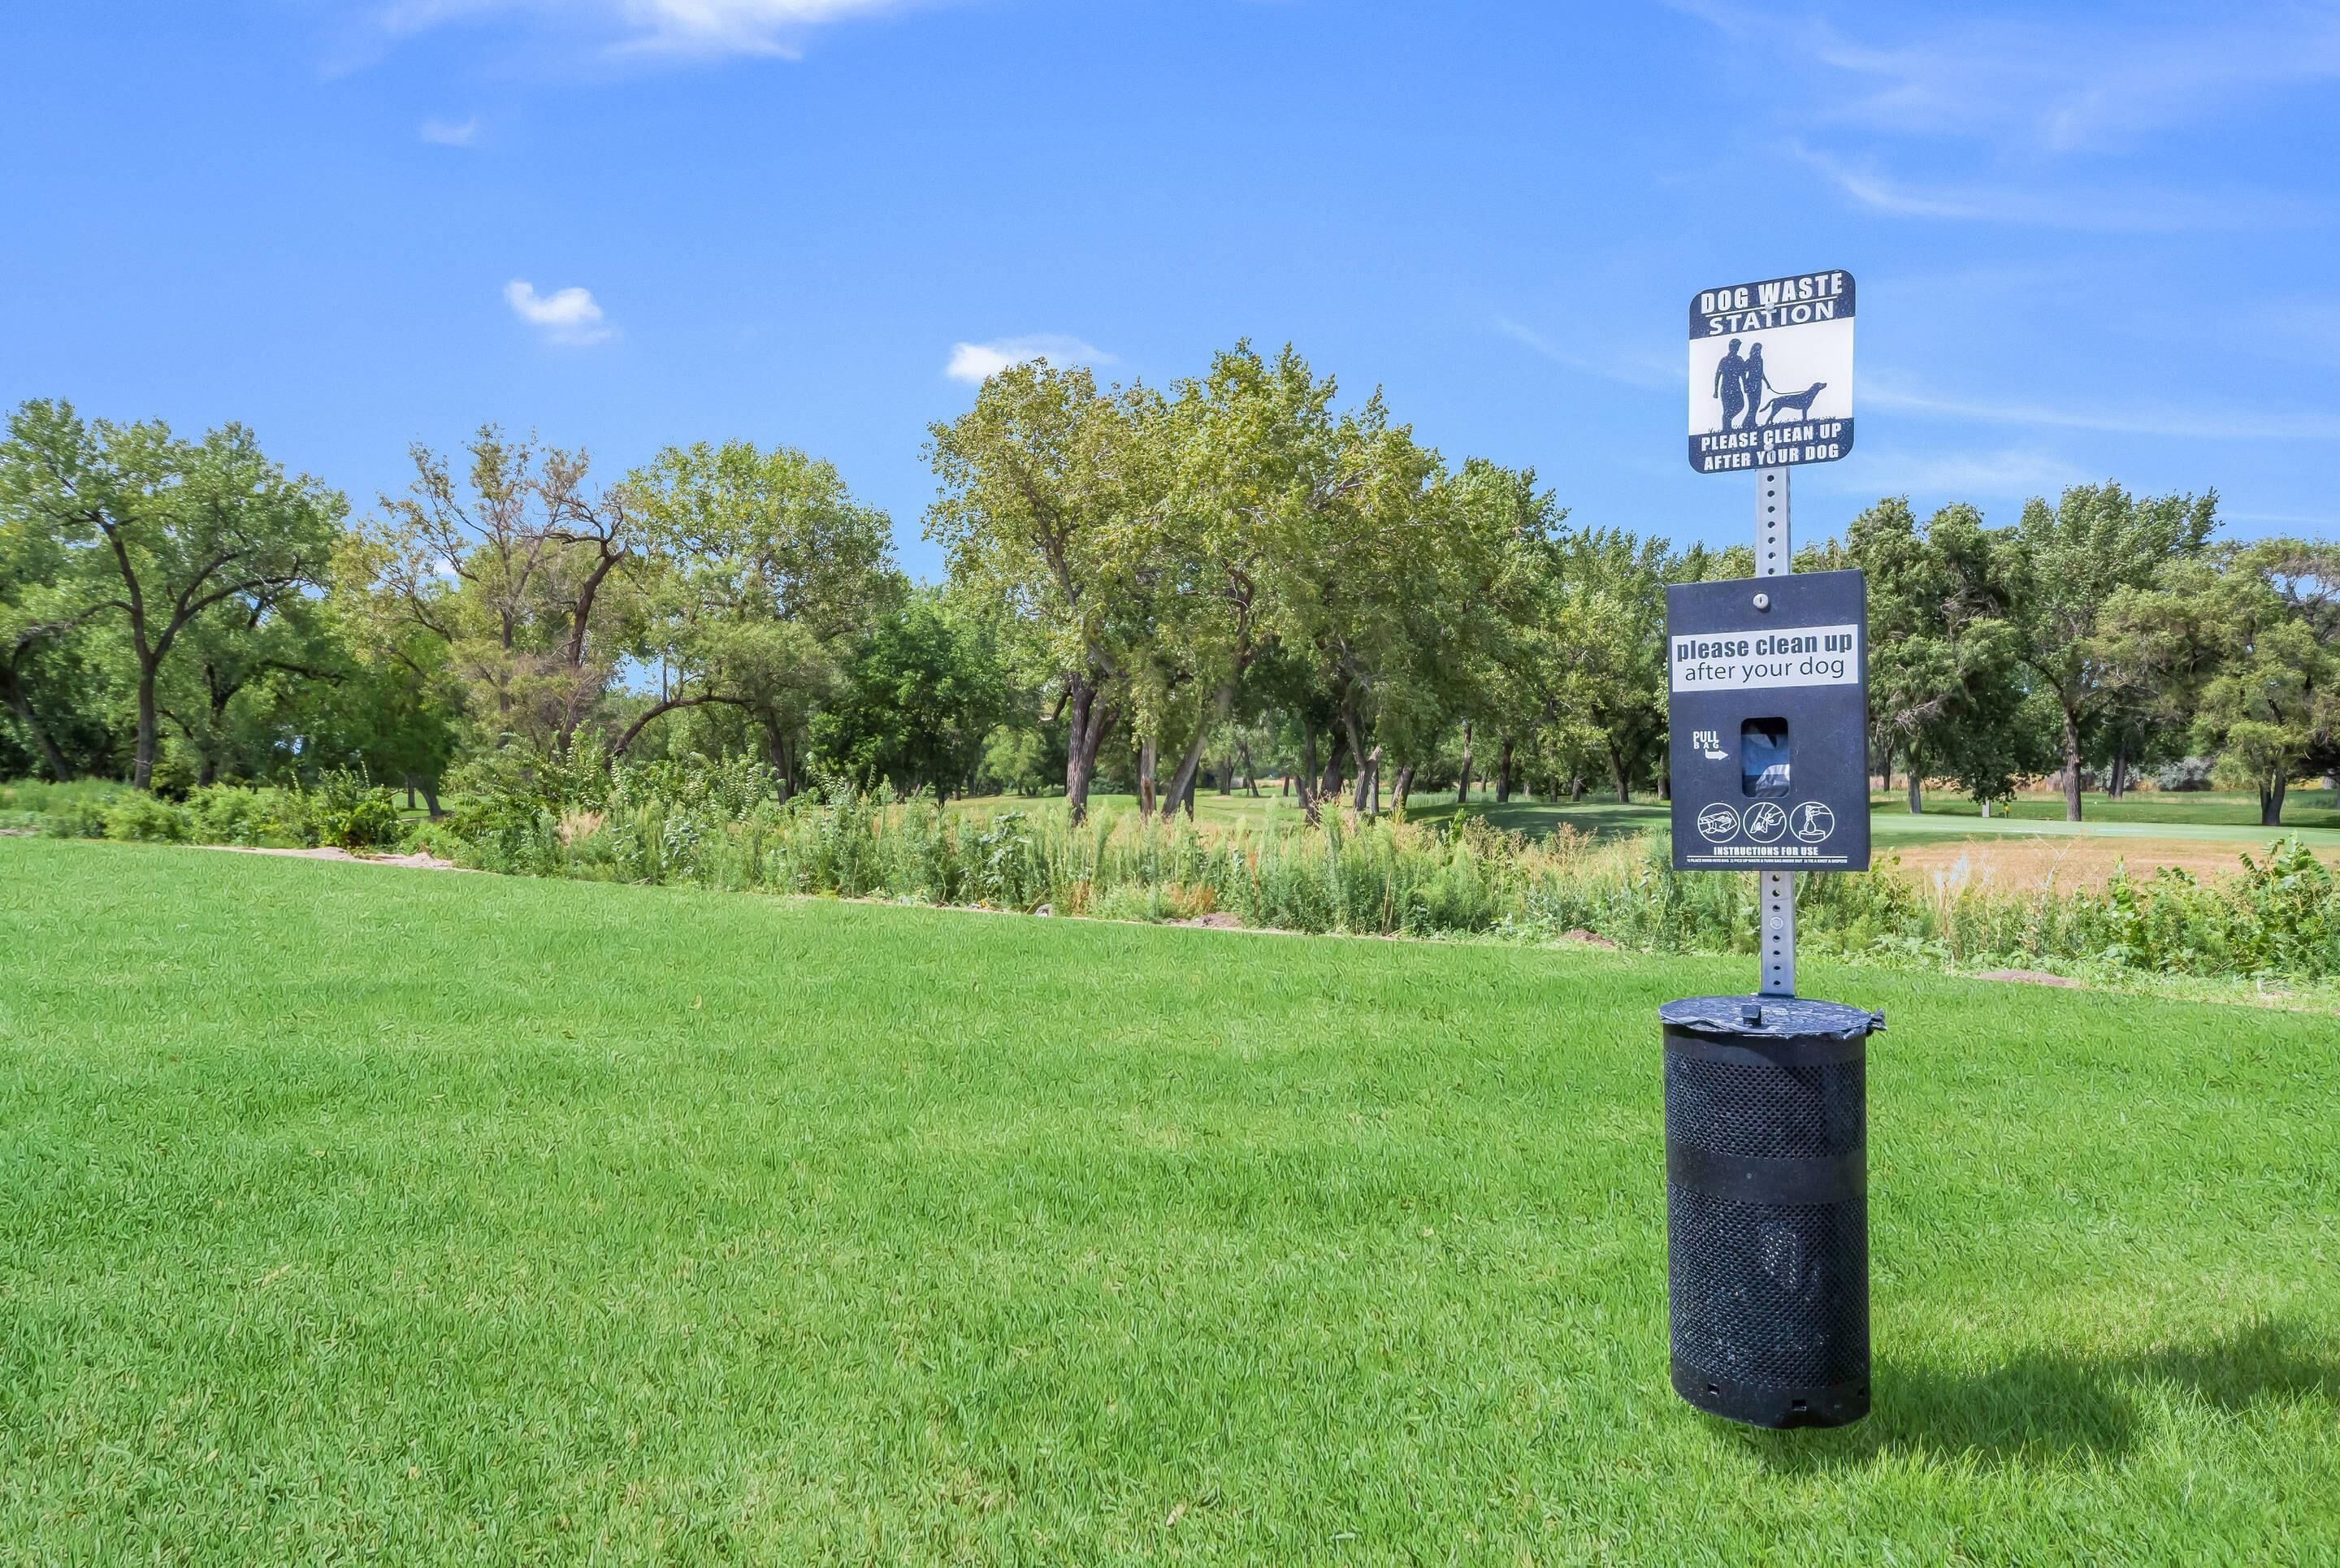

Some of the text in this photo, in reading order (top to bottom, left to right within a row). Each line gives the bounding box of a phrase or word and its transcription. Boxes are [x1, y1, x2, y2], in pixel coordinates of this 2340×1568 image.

[1701, 272, 1843, 314] DOG WASTE
[1709, 301, 1834, 335] STATION
[1701, 422, 1842, 452] PLEASE CLEAN UP
[1704, 444, 1839, 470] AFTER YOUR DOG
[1677, 633, 1852, 662] please clean up
[1685, 656, 1844, 683] after your dog
[1693, 731, 1719, 743] PULL
[1714, 847, 1819, 855] INSTRUCTIONS FOR USE
